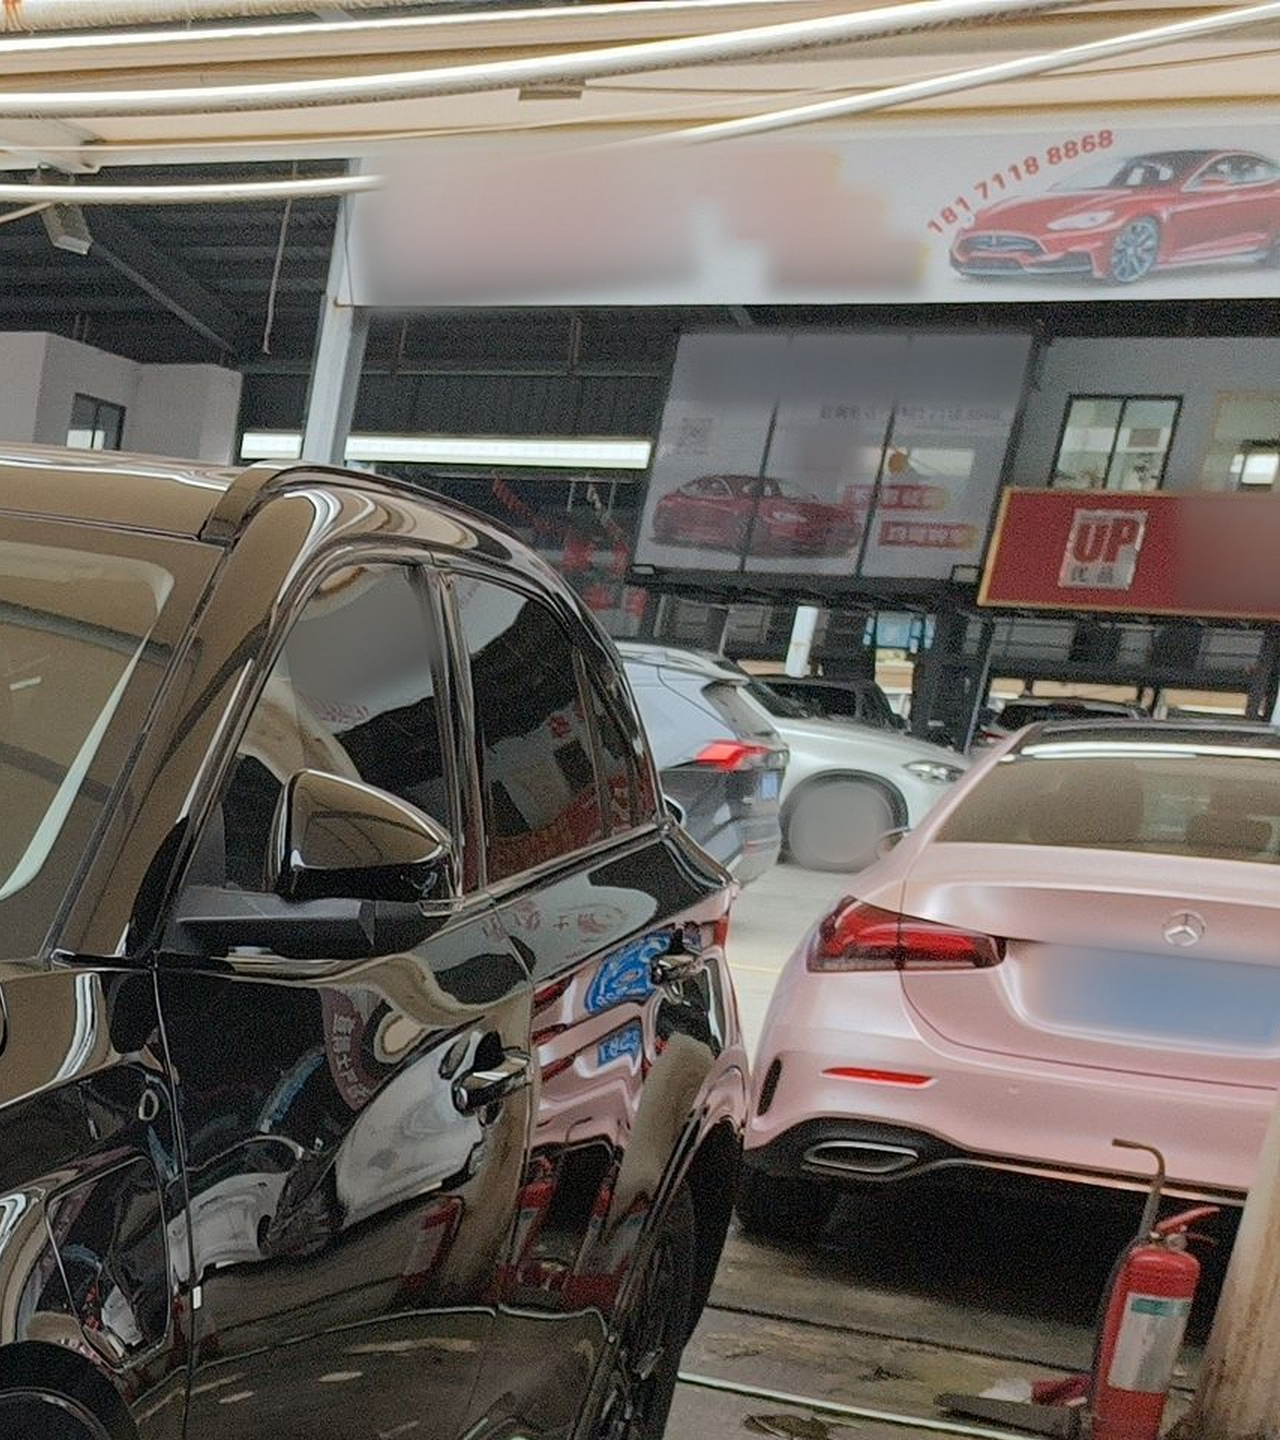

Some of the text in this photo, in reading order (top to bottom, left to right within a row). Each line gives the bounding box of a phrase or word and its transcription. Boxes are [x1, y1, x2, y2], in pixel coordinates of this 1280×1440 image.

[927, 129, 1114, 234] 181 7118 8868
[1073, 519, 1140, 563] UP
